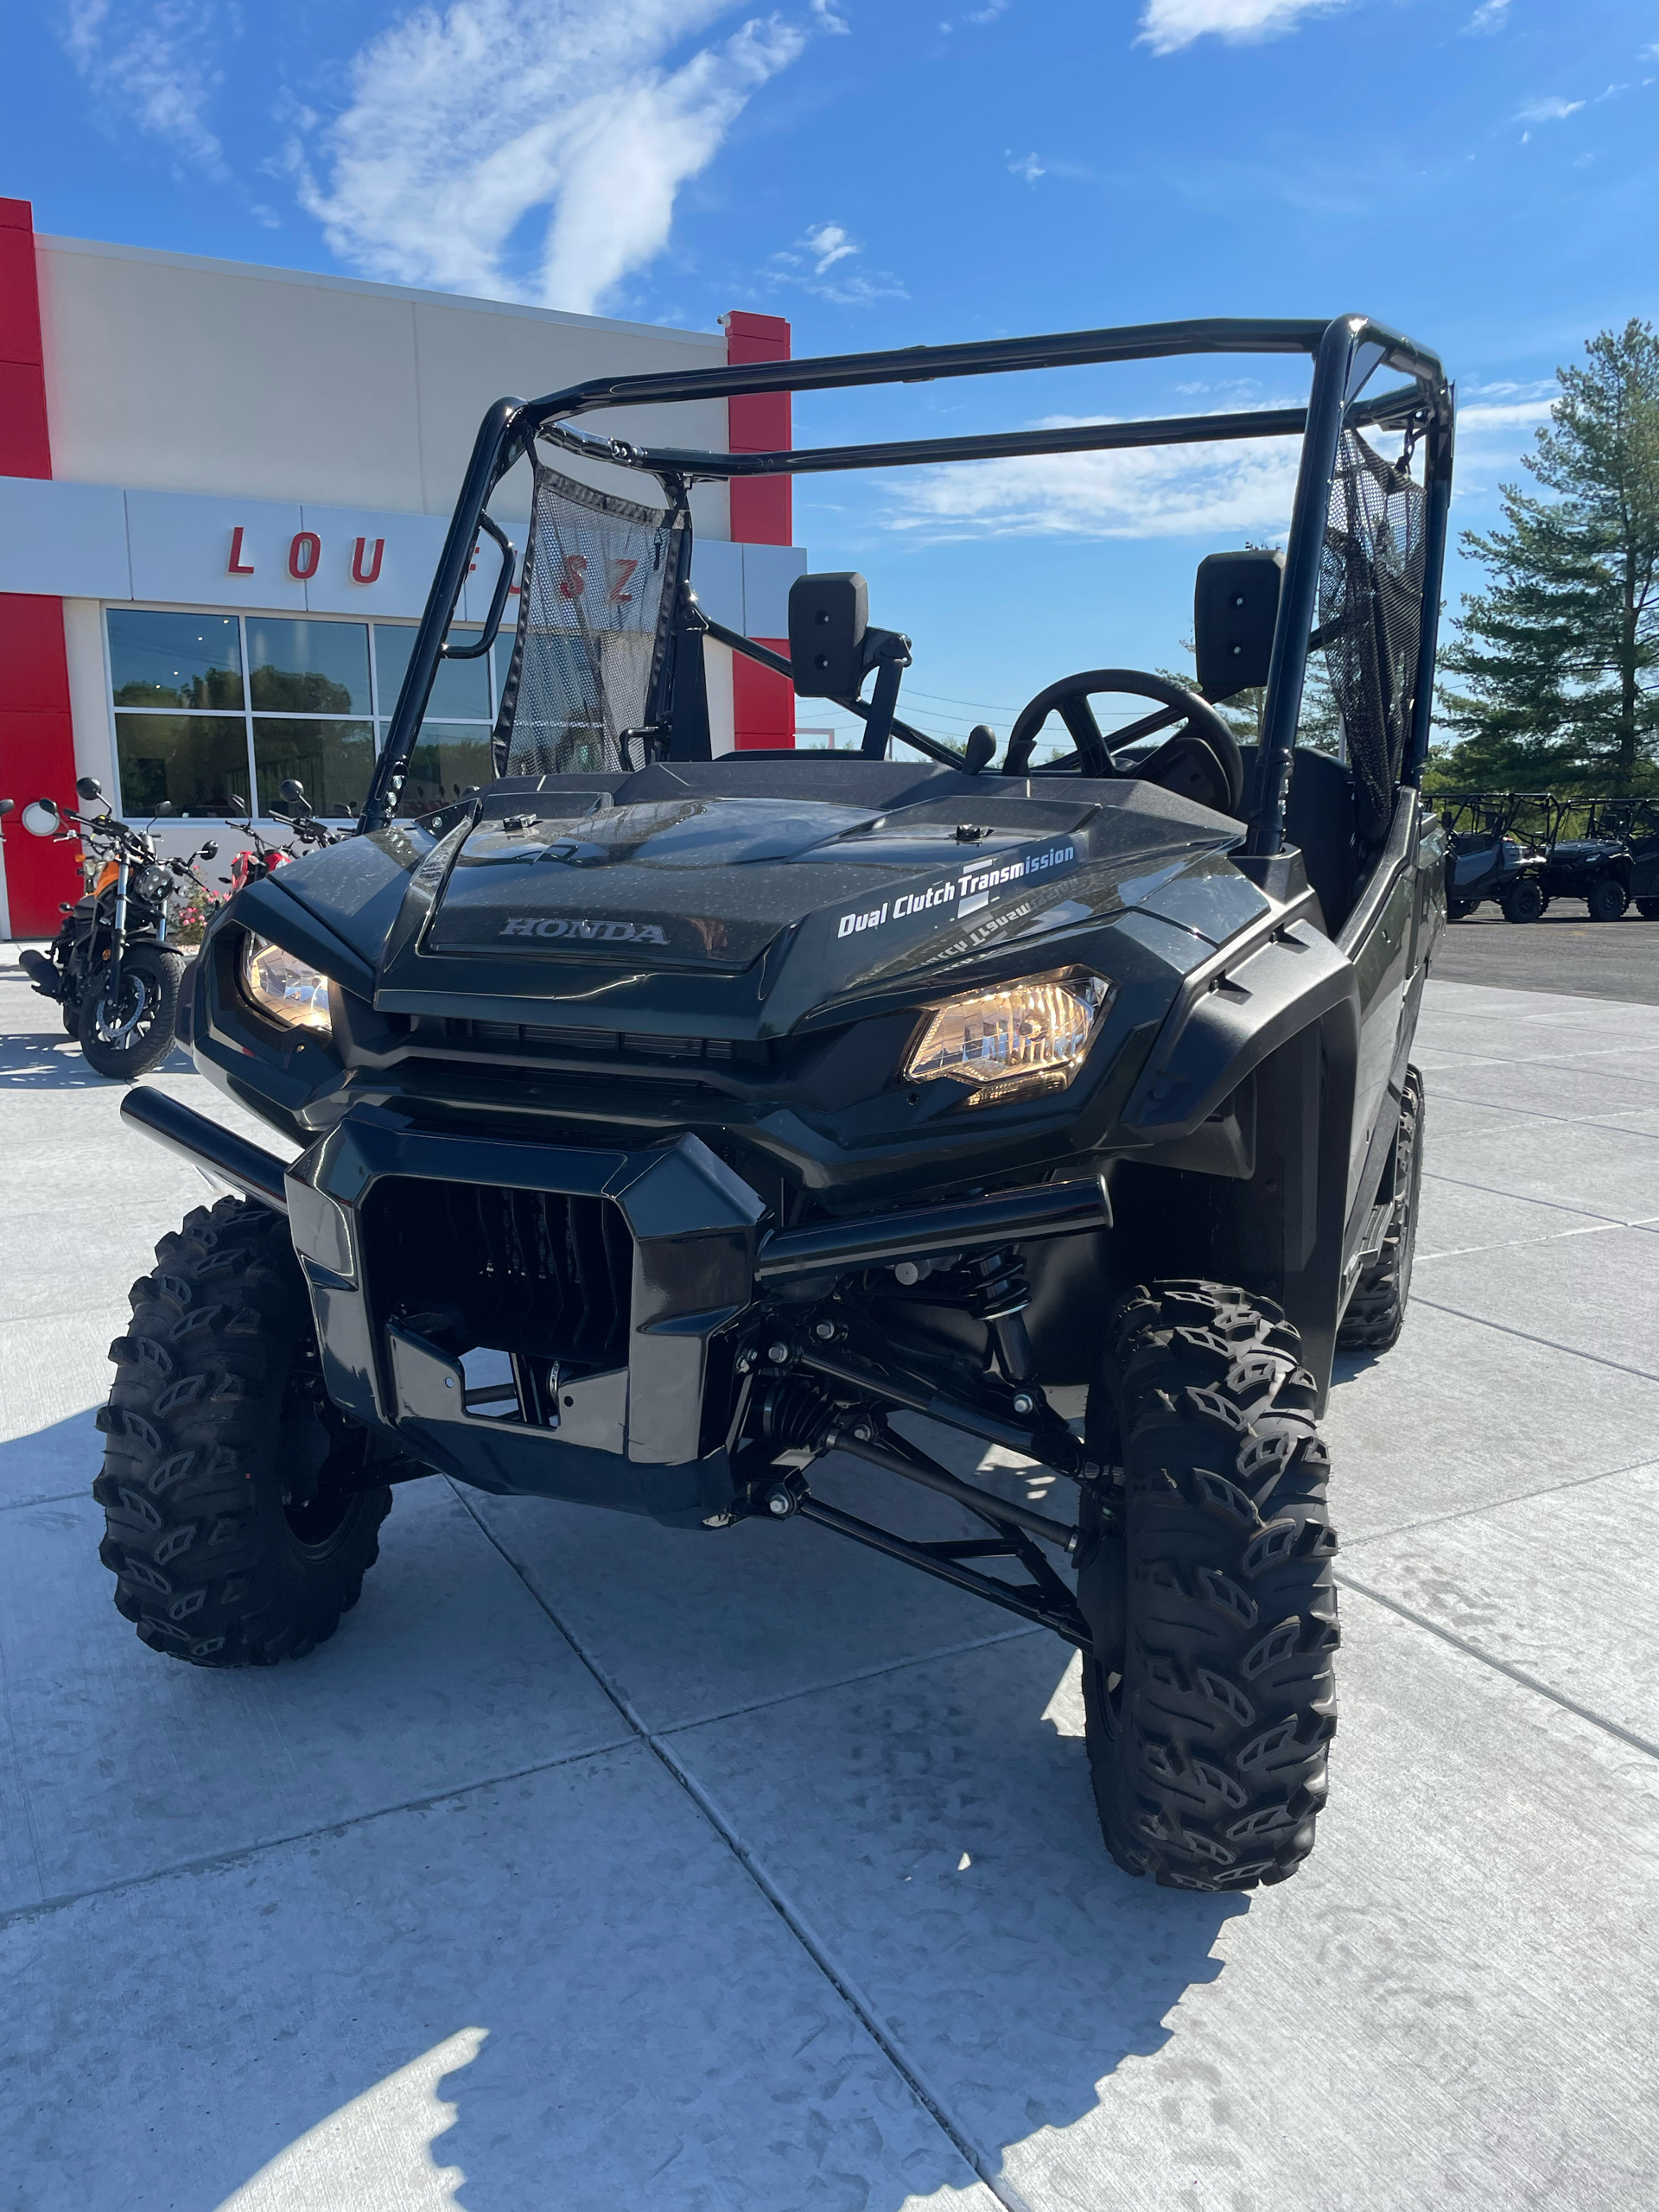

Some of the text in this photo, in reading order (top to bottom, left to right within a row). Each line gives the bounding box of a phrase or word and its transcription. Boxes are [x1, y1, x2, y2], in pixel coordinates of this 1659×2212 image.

[227, 526, 639, 602] LOU SZ
[837, 846, 1074, 938] Dual Clutch Transmission
[498, 918, 671, 945] HONDA
